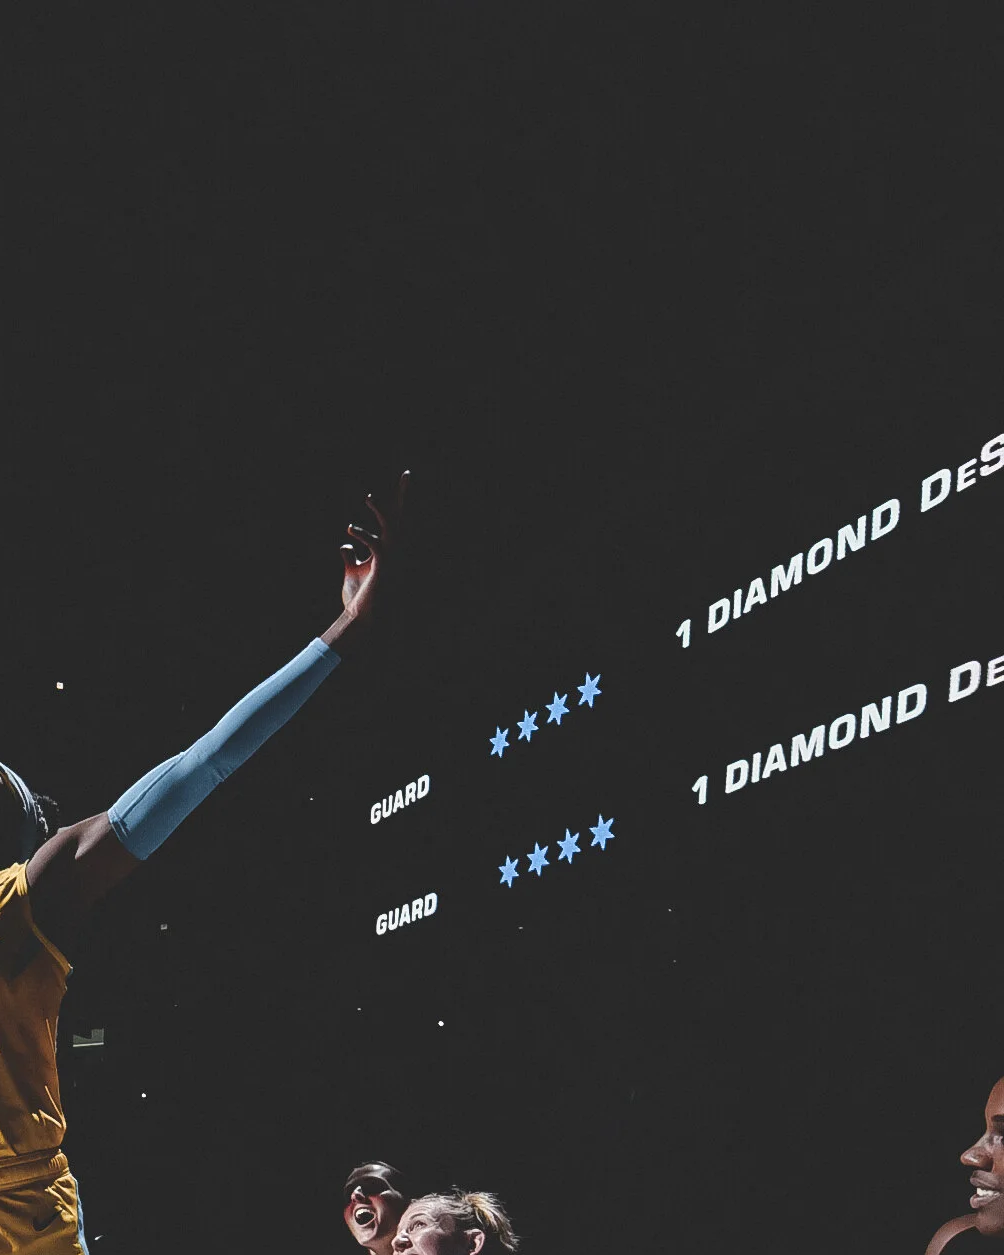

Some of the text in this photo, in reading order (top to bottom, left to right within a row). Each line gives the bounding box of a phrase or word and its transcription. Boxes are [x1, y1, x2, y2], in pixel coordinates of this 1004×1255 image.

[676, 619, 692, 648] 1
[708, 499, 900, 633] DIAMOND
[692, 775, 709, 804] 1
[725, 684, 927, 794] DIAMOND
[370, 775, 430, 825] GUARD
[376, 893, 437, 935] GUARD
